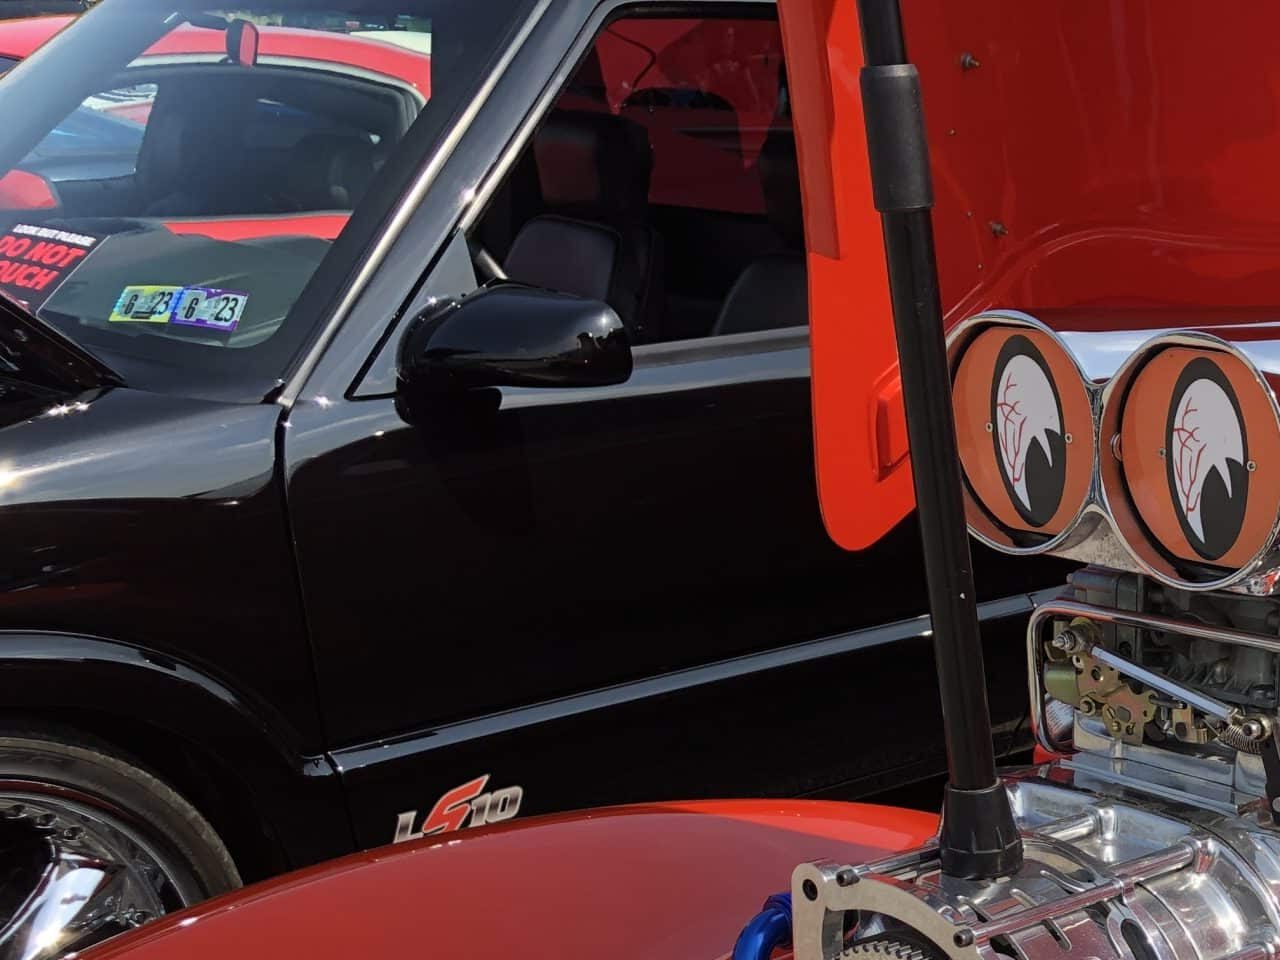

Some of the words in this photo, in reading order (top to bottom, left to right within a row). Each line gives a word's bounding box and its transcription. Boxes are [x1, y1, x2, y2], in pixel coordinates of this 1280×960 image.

[0, 236, 31, 257] DO
[24, 241, 86, 268] NOT
[125, 294, 138, 314] 6
[150, 292, 173, 315] 23
[184, 297, 199, 319] 6
[215, 296, 239, 322] 23
